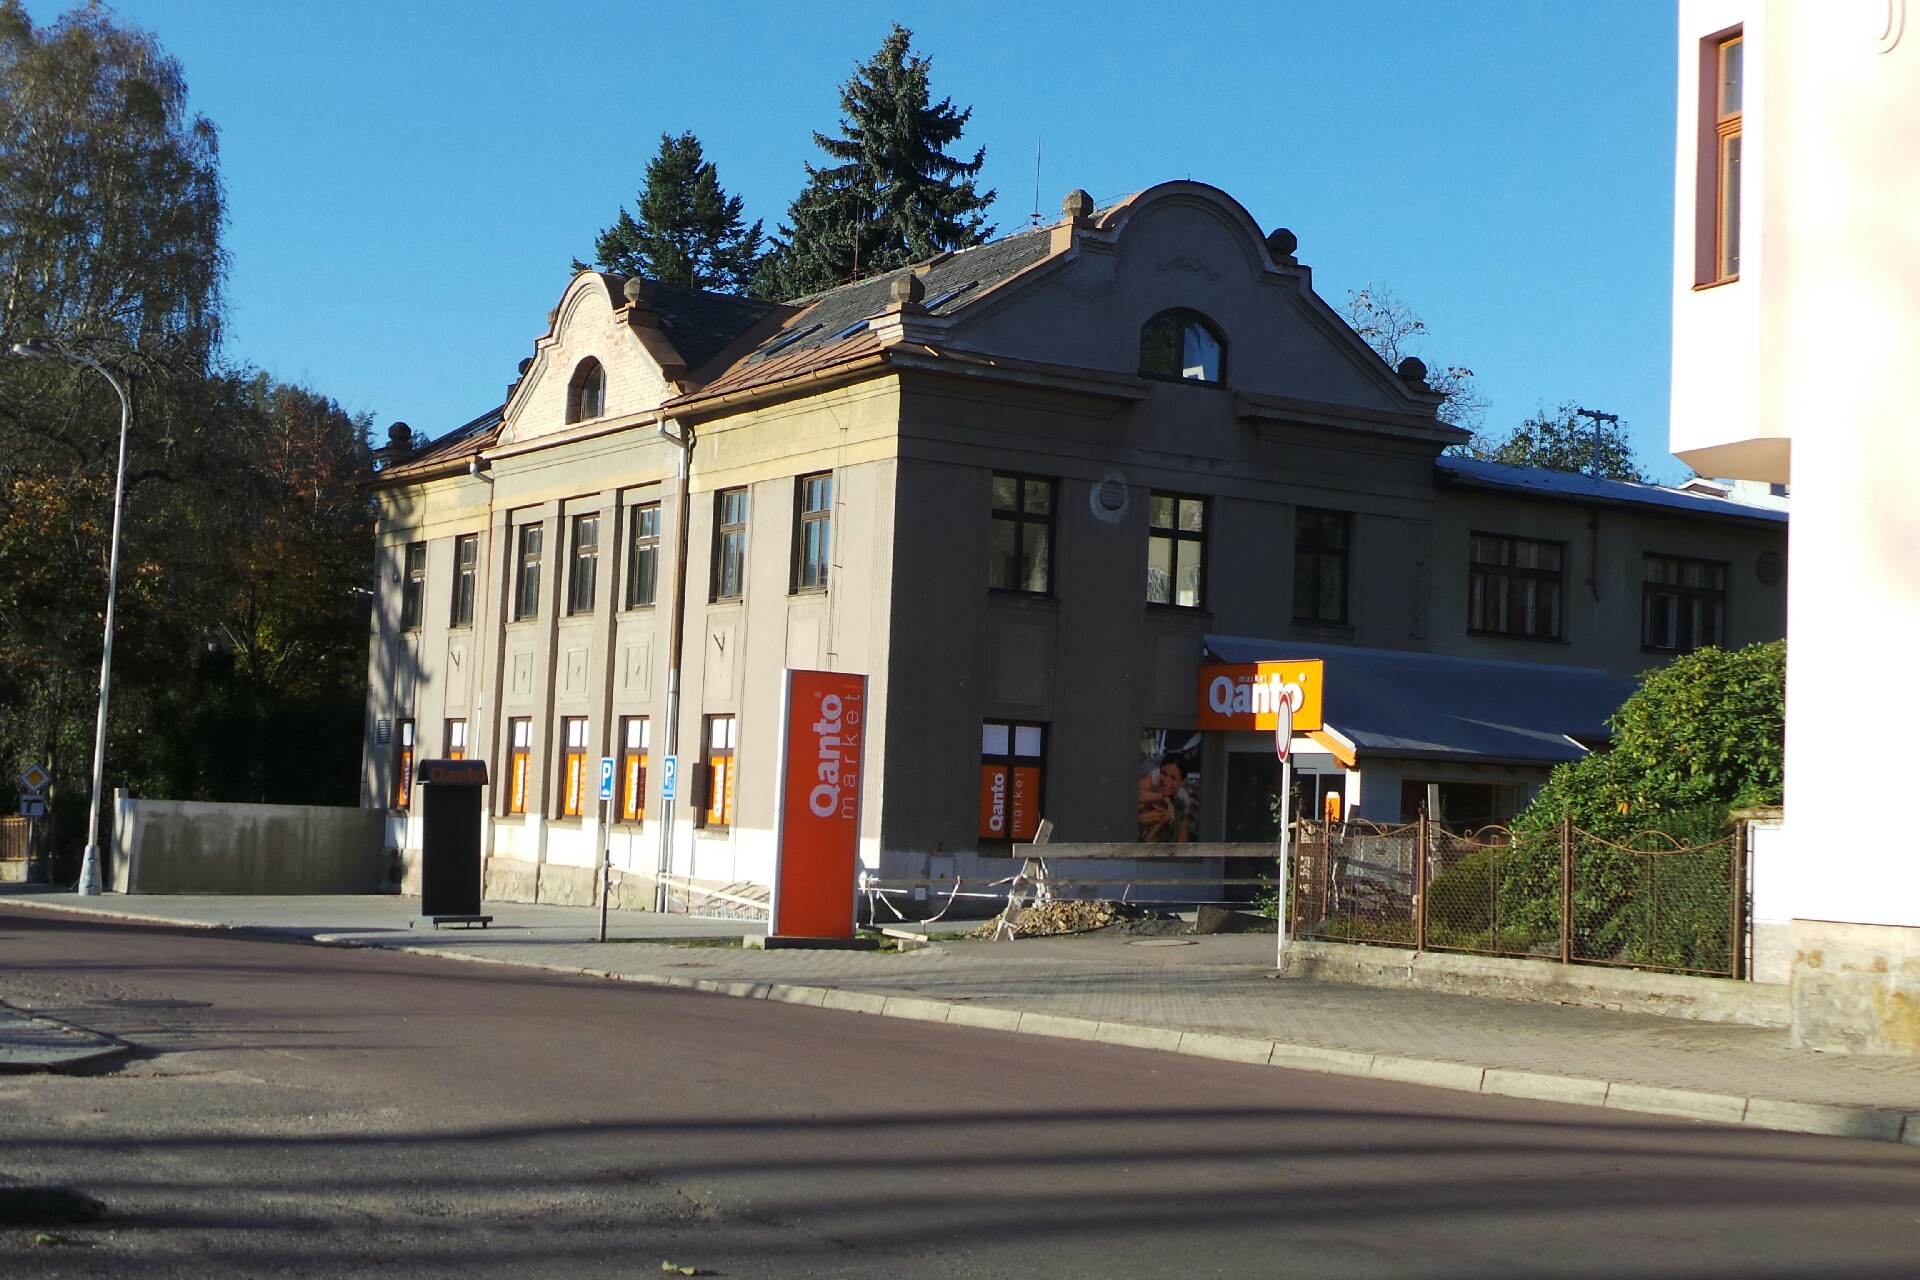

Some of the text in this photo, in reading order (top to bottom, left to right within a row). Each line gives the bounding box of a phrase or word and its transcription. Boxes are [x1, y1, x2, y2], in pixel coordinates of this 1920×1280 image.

[1209, 672, 1305, 718] Qanto
[1238, 673, 1269, 683] market
[430, 767, 487, 783] Qanto
[602, 762, 611, 787] P
[664, 761, 674, 786] P
[809, 694, 843, 818] Qanto
[840, 693, 860, 820] market
[713, 763, 725, 818] Qanto
[989, 773, 1004, 831] Qanto
[1013, 772, 1024, 832] market
